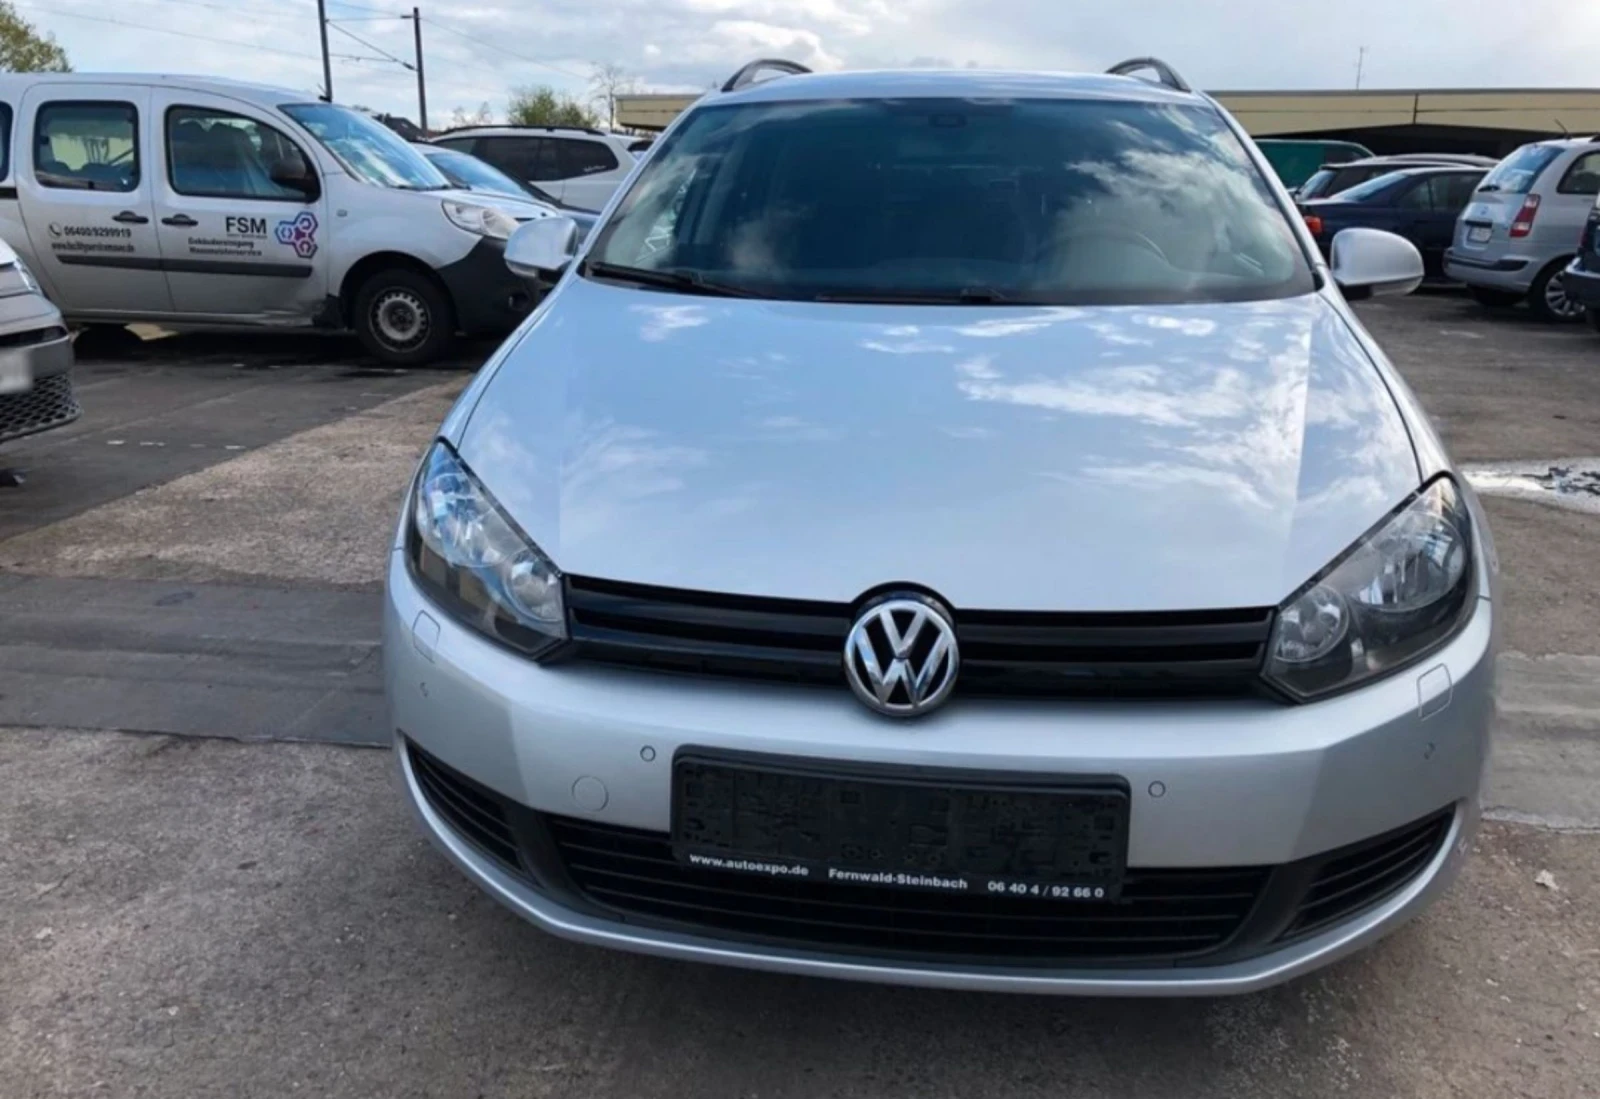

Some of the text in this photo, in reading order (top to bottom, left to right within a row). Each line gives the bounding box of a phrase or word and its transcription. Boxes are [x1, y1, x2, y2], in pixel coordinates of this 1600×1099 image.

[225, 216, 267, 234] FSM
[689, 853, 809, 876] www.autoexpo.de
[828, 868, 968, 889] Fernwald-Steinbach
[987, 881, 1005, 892] 06
[1009, 883, 1027, 894] 40
[1030, 884, 1040, 895] 4
[1052, 886, 1069, 897] 92
[1073, 887, 1091, 898] 66
[1094, 887, 1104, 898] 0
